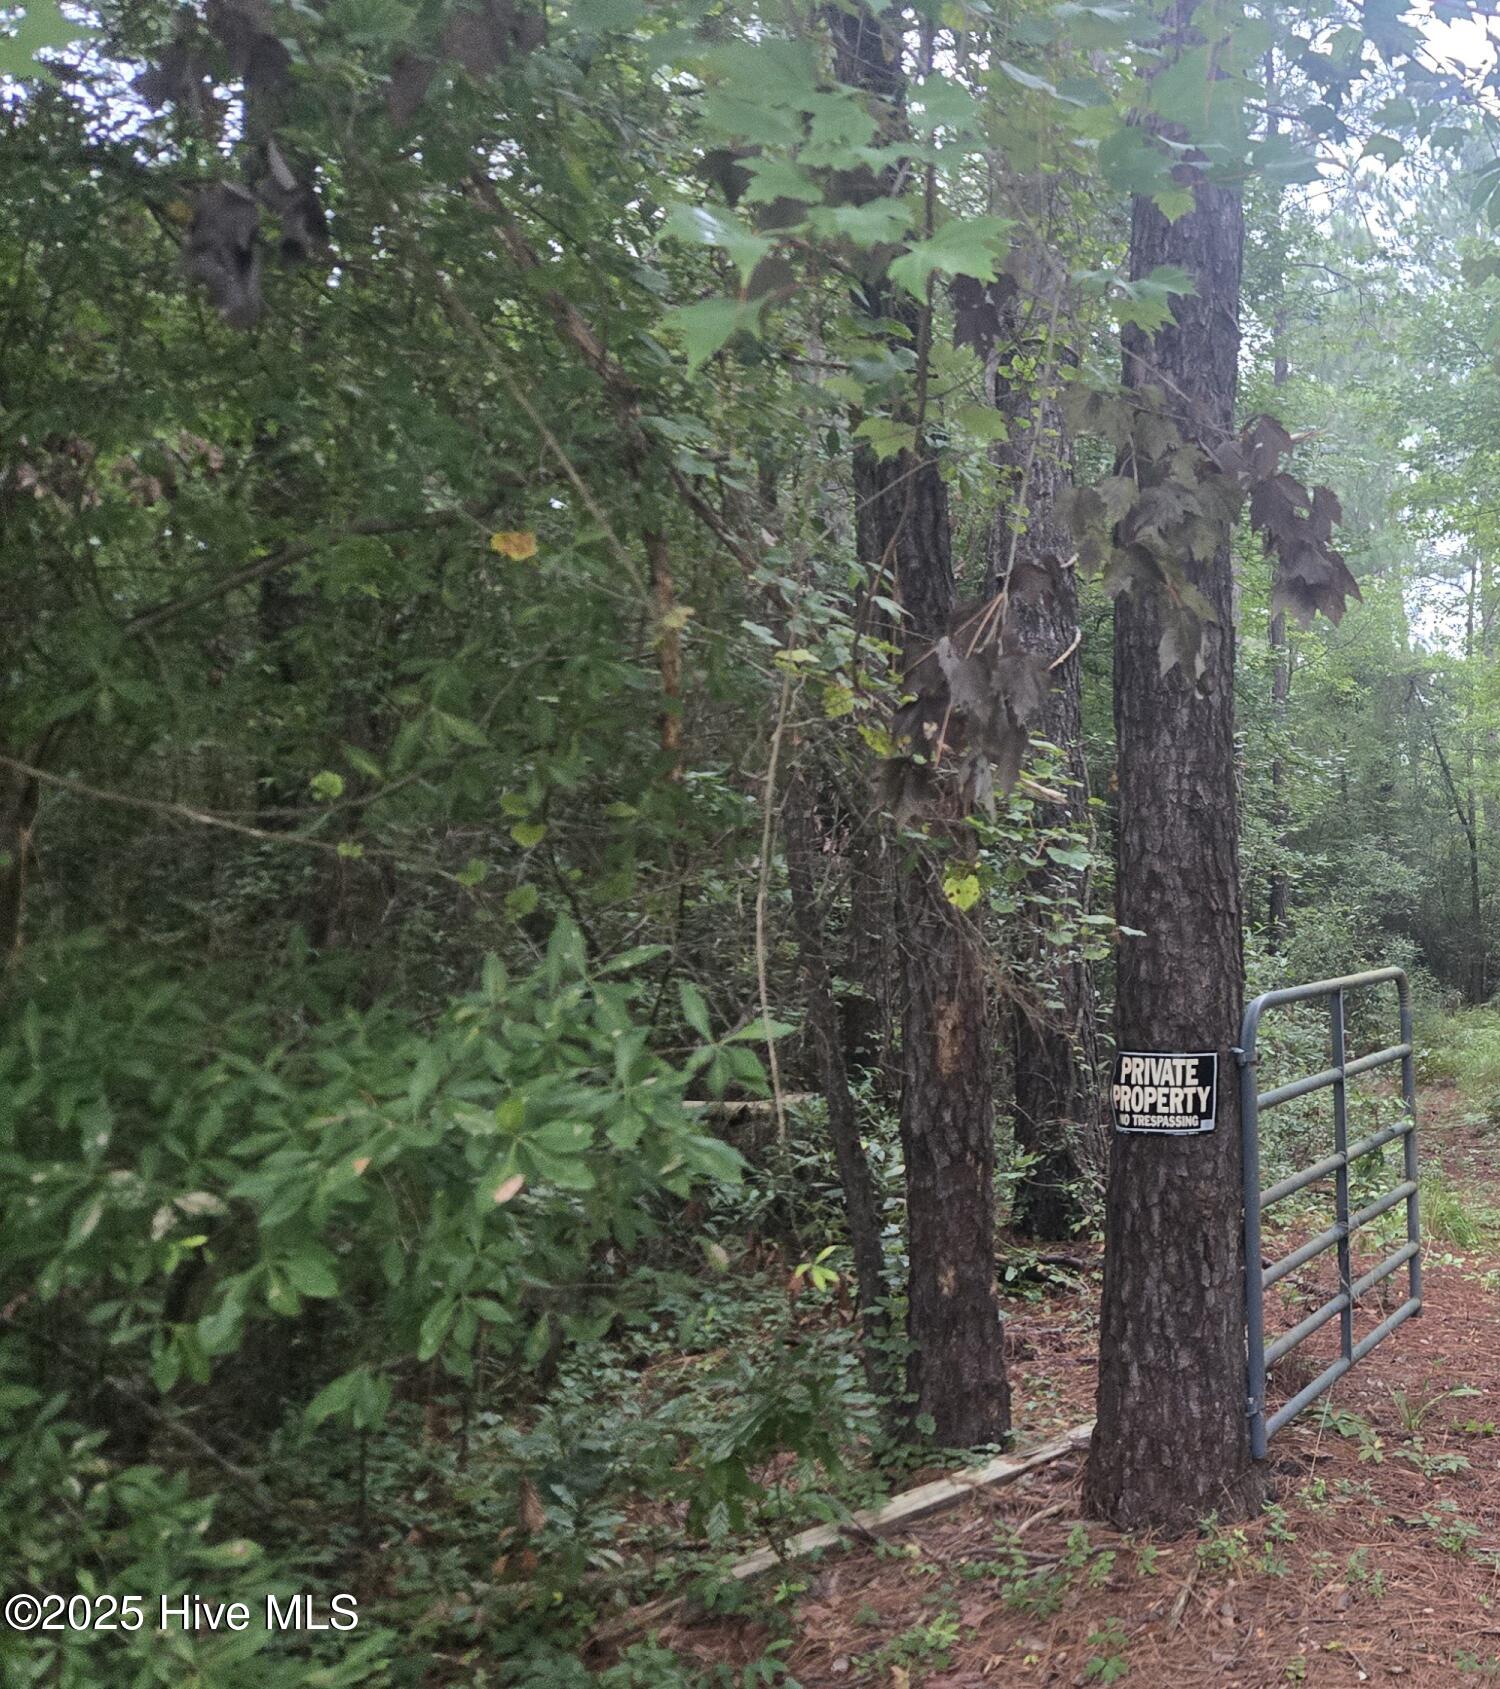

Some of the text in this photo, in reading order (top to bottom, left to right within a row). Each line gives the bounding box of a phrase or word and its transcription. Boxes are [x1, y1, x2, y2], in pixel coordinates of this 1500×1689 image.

[1120, 1056, 1199, 1086] PRIVATE
[1113, 1084, 1211, 1114] PROPERTY
[1132, 1114, 1199, 1128] TRESPASSING
